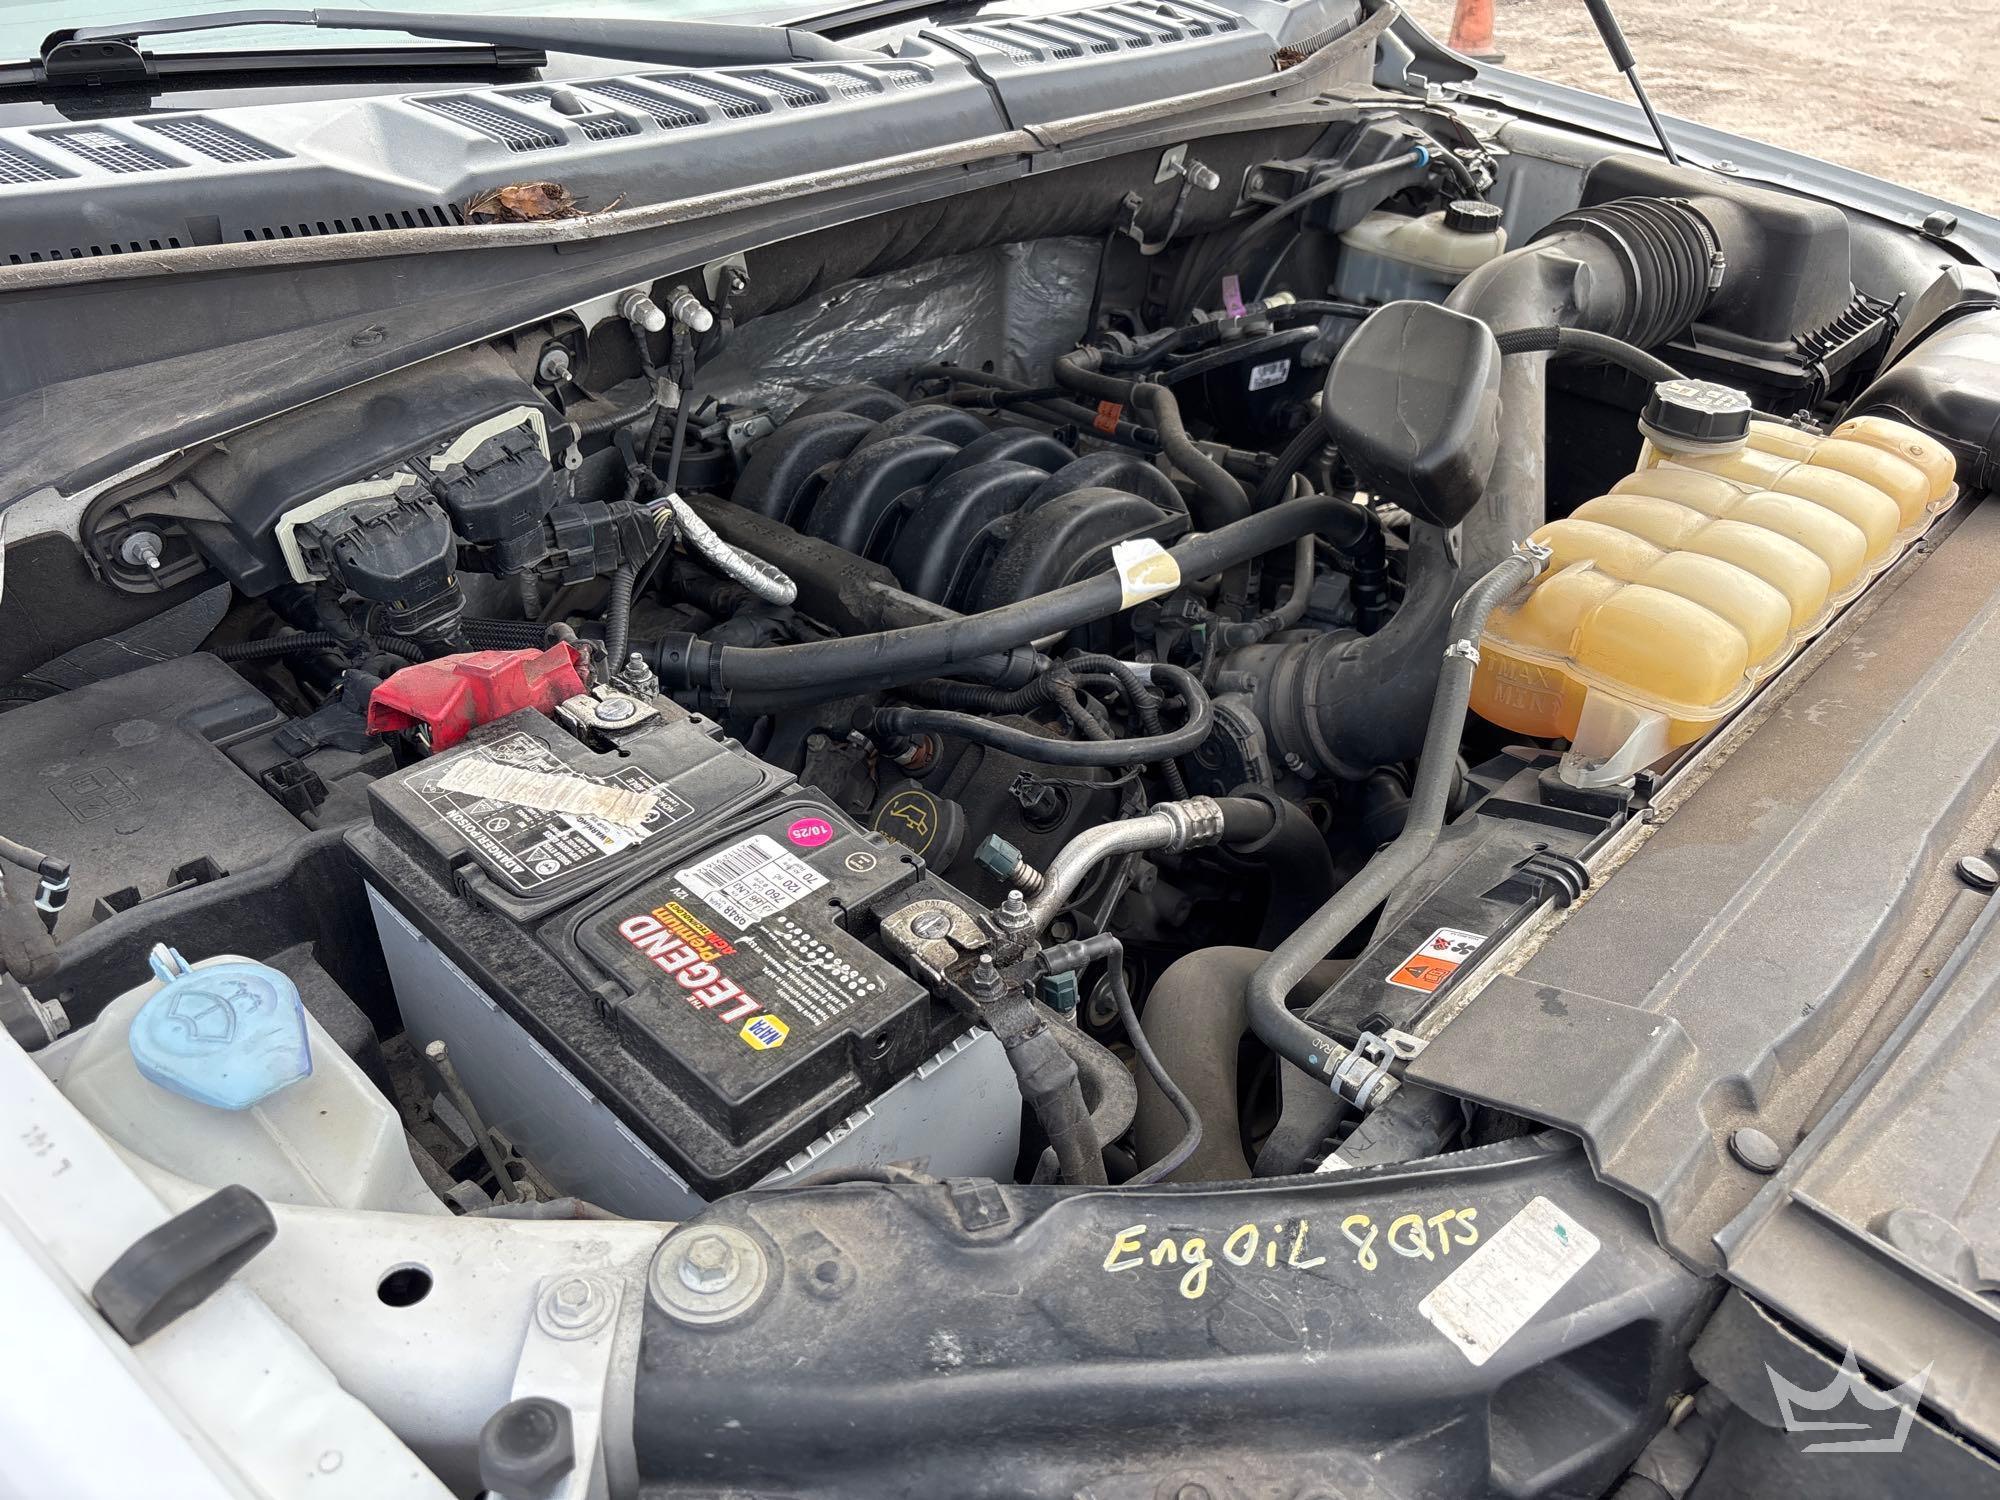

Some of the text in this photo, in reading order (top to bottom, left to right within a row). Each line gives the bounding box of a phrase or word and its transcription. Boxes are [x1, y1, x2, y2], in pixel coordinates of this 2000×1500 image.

[444, 808, 518, 868] DANGER/POISON
[791, 824, 828, 838] 10/25
[781, 879, 801, 893] 120
[801, 872, 818, 884] 70
[669, 886, 690, 899] 12V
[731, 882, 750, 895] LN3
[763, 888, 785, 903] 760
[748, 894, 763, 904] H6
[647, 906, 722, 963] Premium
[667, 901, 737, 956] AGM TECHNOLOGY
[619, 915, 762, 1024] LEGEND
[684, 994, 705, 1010] THE
[746, 1018, 782, 1045] NAPA
[1312, 1038, 1333, 1054] RAD
[1103, 1224, 1213, 1299] Eng
[1341, 1213, 1378, 1271] 8
[1387, 1207, 1480, 1262] QTS
